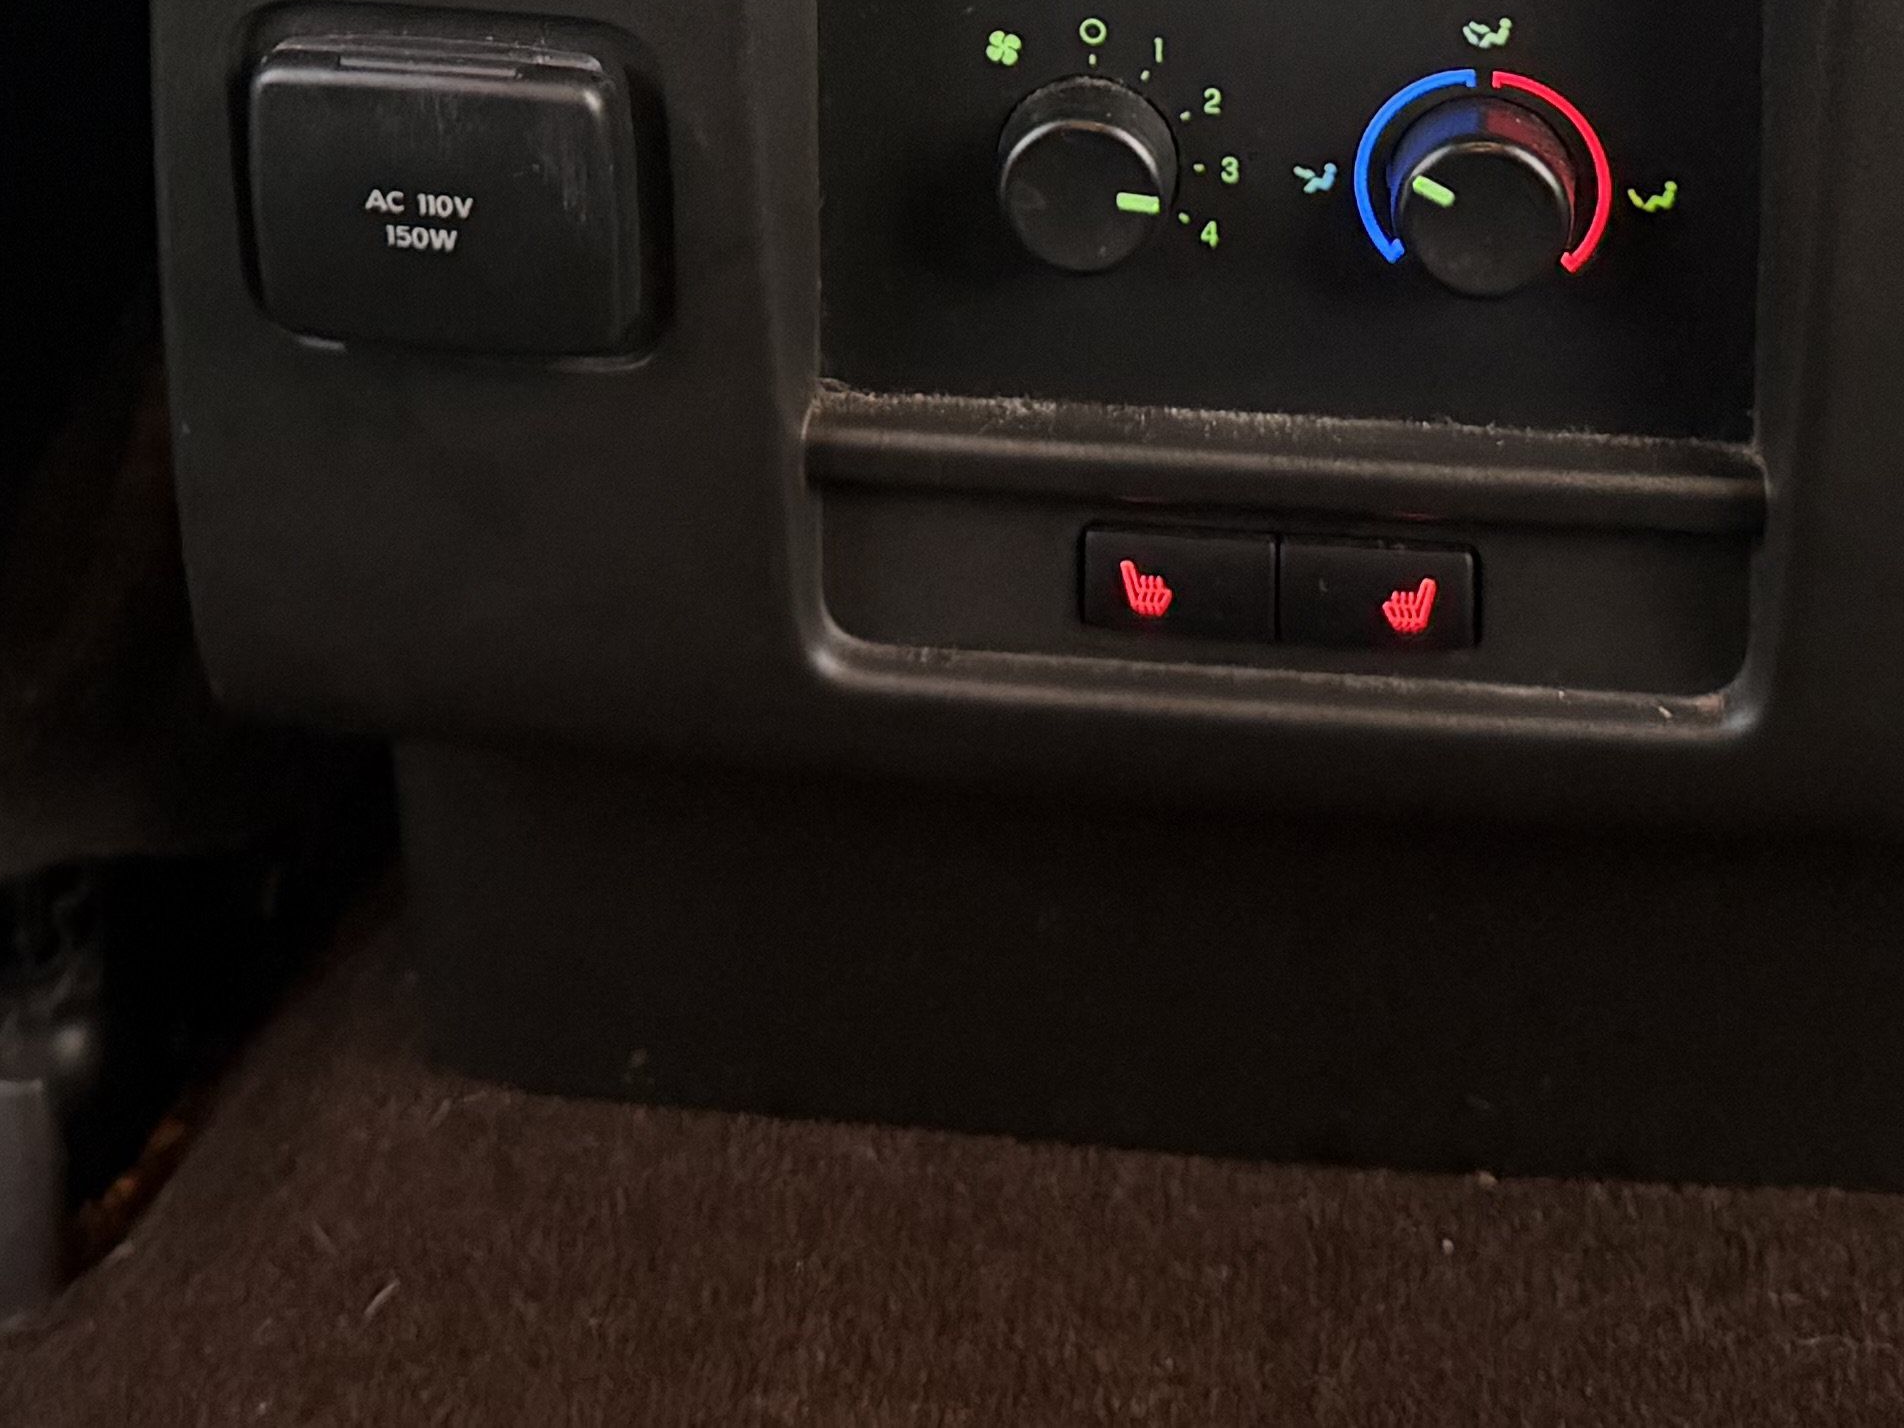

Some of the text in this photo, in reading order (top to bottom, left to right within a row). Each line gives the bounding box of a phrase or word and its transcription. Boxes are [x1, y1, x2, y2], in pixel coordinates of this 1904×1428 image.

[1153, 37, 1164, 63] 1
[1203, 88, 1223, 115] 2
[1220, 156, 1240, 184] 3
[364, 188, 474, 219] AC 110V
[385, 223, 459, 252] 150W
[1200, 221, 1220, 248] 4
